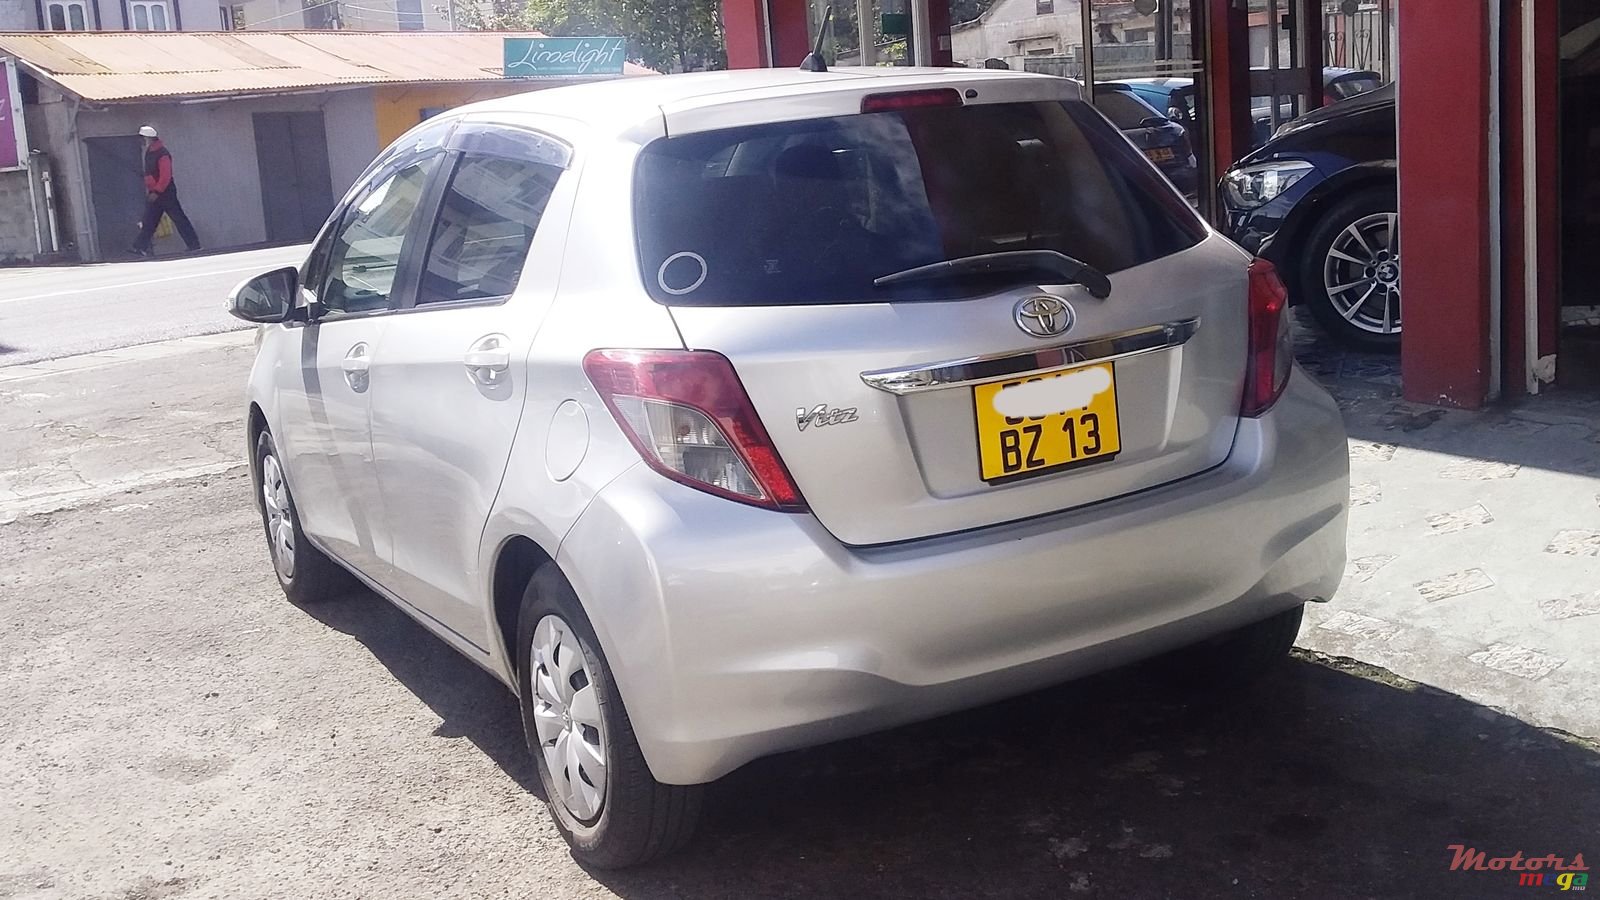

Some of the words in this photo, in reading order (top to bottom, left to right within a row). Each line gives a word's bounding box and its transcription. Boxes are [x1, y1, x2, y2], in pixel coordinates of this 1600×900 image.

[508, 39, 622, 73] Limelight
[796, 404, 859, 431] Vitz
[1000, 424, 1045, 473] BZ
[1061, 413, 1101, 459] 13
